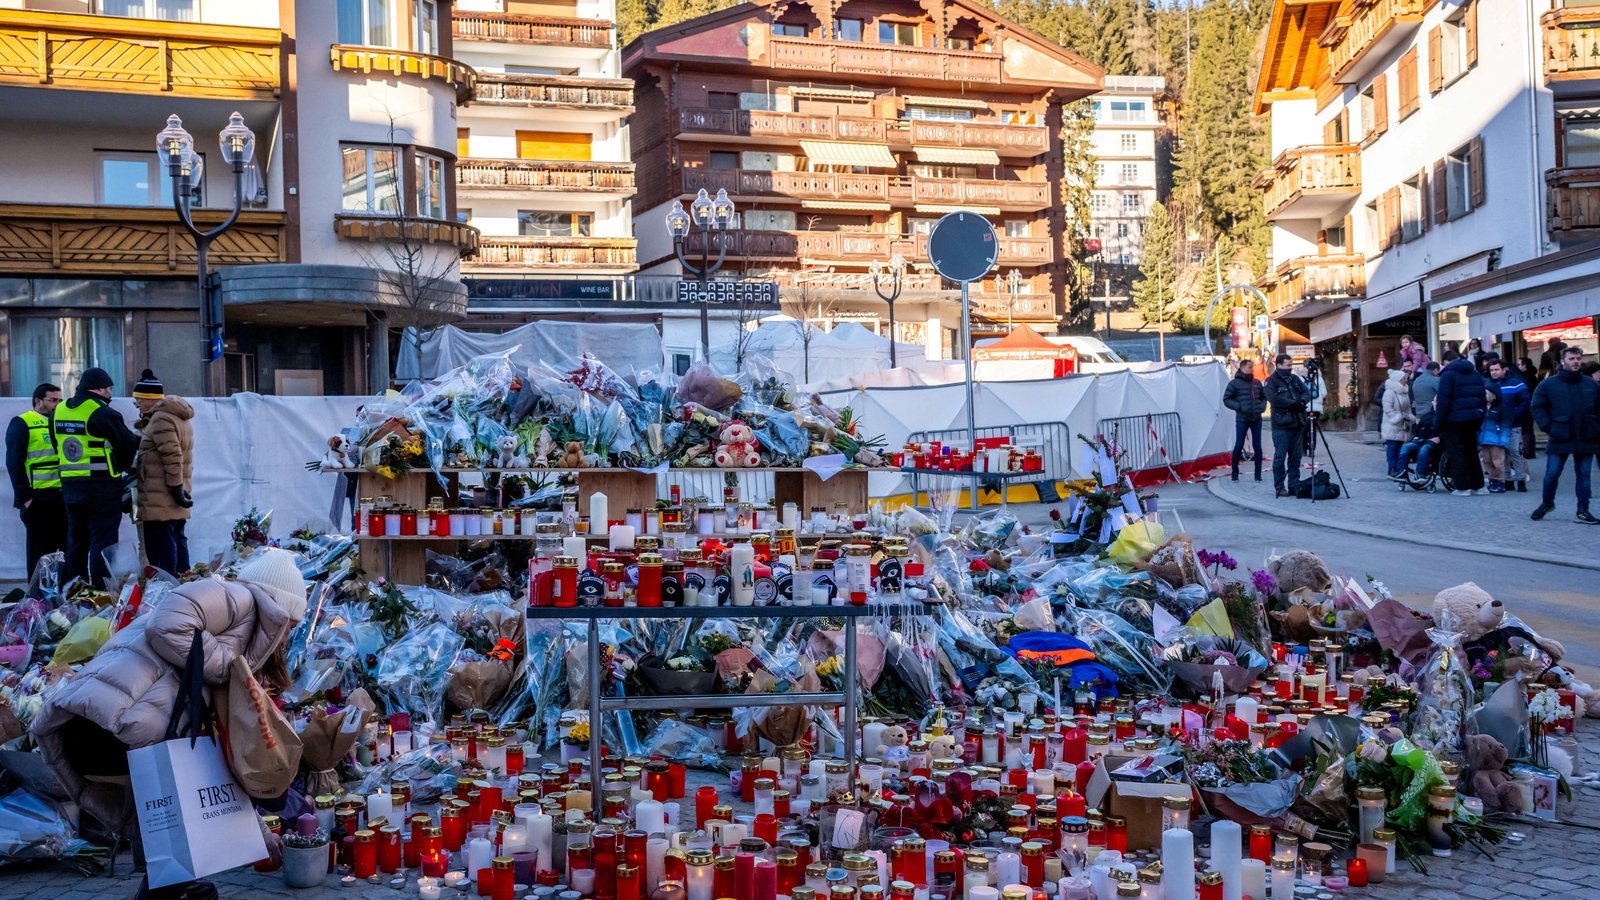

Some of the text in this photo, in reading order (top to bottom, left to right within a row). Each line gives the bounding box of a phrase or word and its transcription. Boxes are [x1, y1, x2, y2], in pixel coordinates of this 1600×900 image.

[580, 286, 610, 294] WINE BAR
[1507, 305, 1554, 325] CIGARES
[145, 795, 173, 811] FIRST
[197, 783, 237, 808] FIRST
[202, 805, 243, 820] CRANS MONTANA
